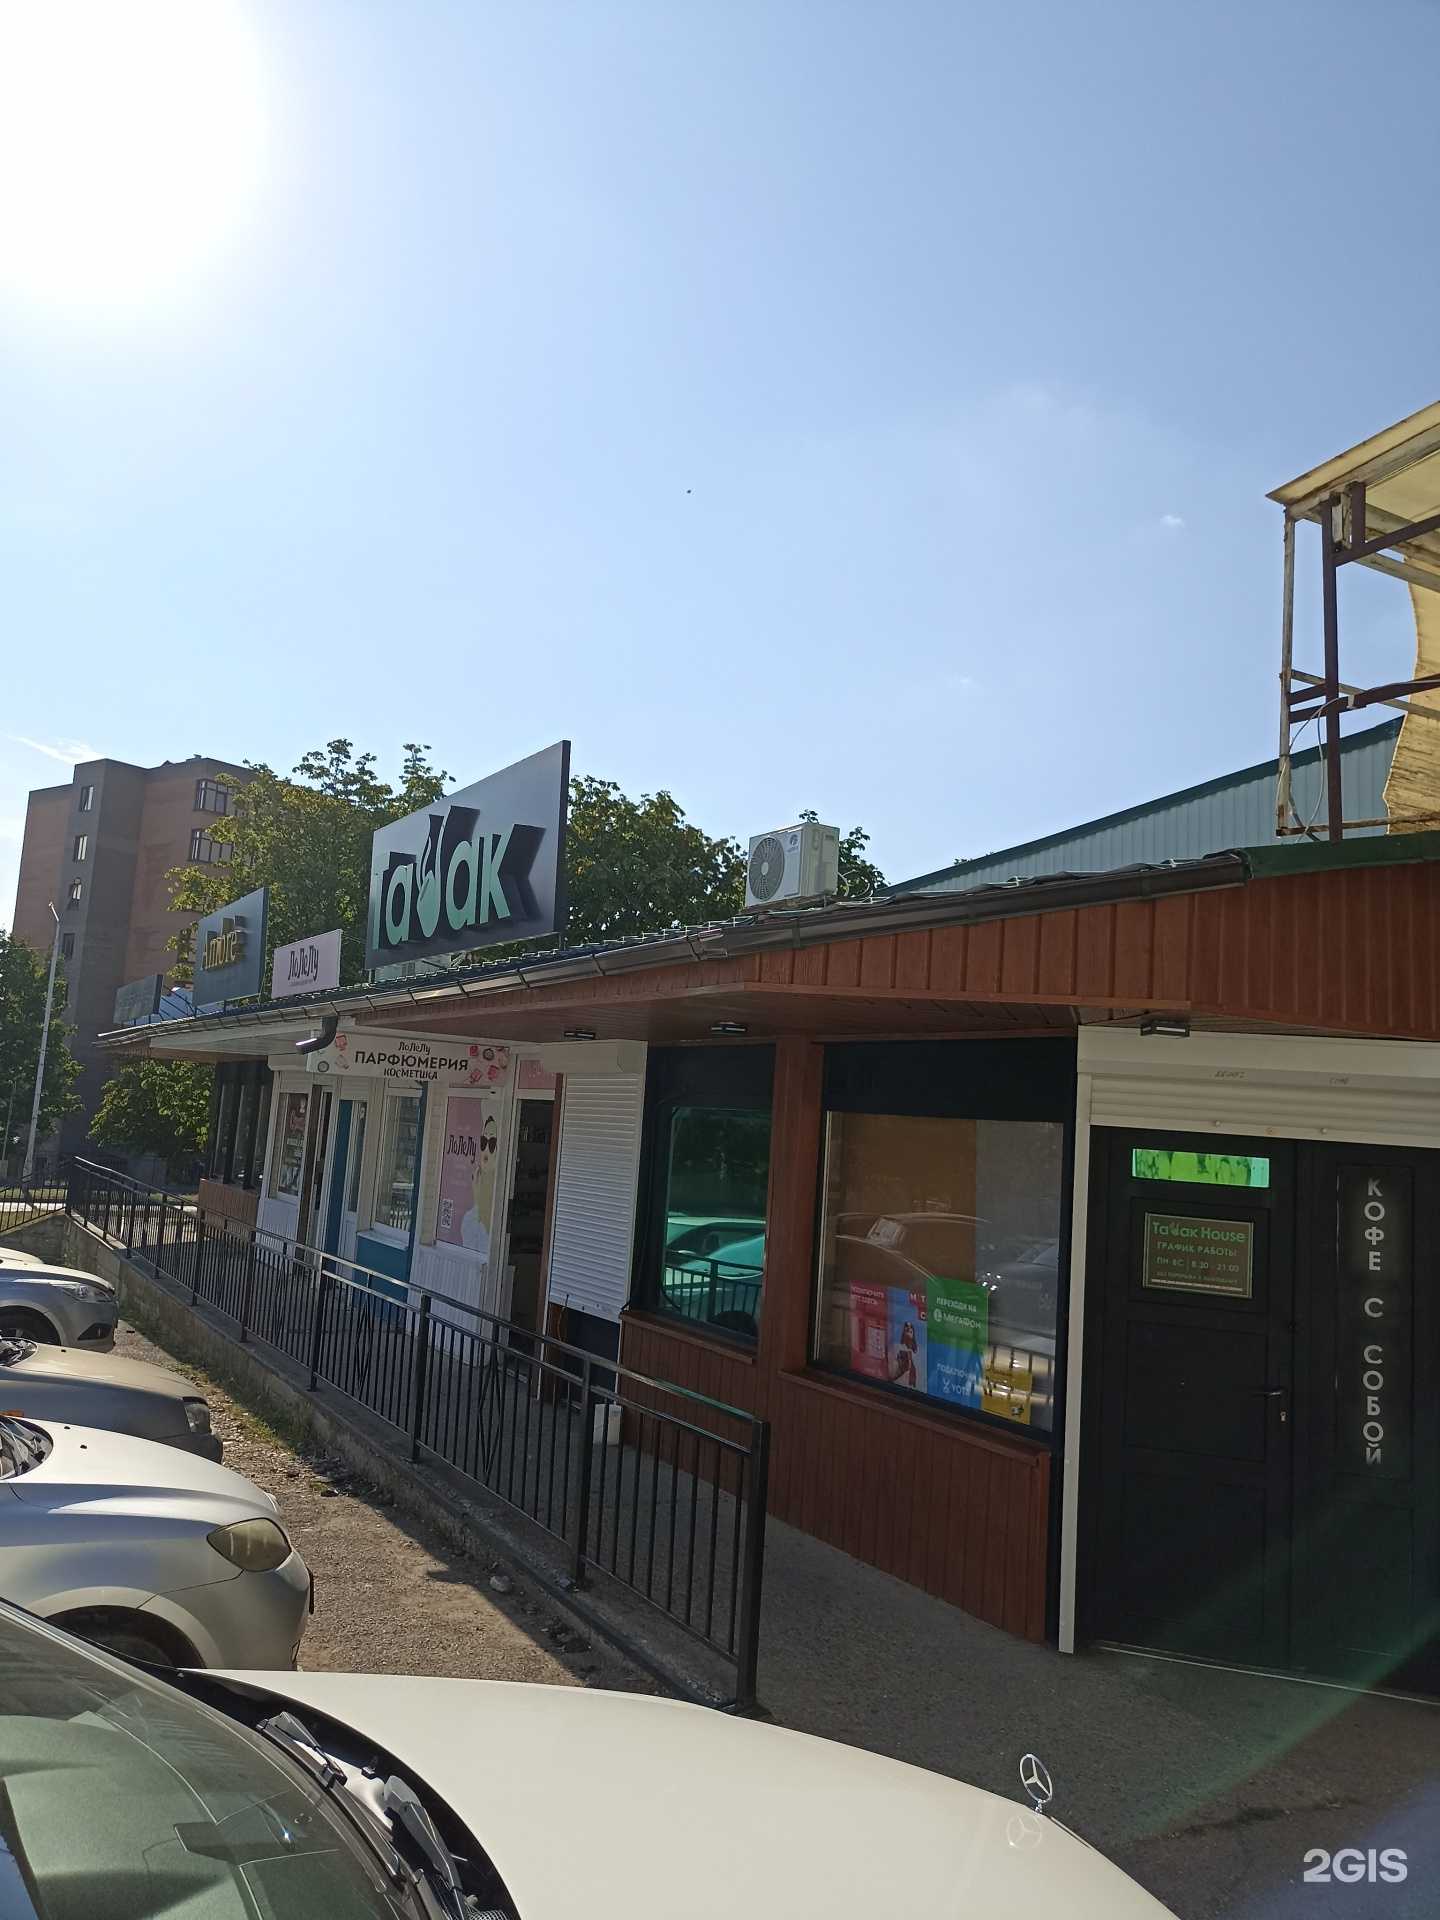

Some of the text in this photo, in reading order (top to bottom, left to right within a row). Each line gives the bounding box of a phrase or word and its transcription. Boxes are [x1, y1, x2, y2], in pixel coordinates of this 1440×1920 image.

[355, 1051, 468, 1071] ПАРФЮМЕРИЯ
[383, 1068, 438, 1080] КОСМЕТИКА
[1201, 1227, 1246, 1243] House
[1157, 1241, 1237, 1257] ГРАФИК РАБОТЫ
[1362, 1177, 1385, 1466] КОФЕ С СОБОЙ
